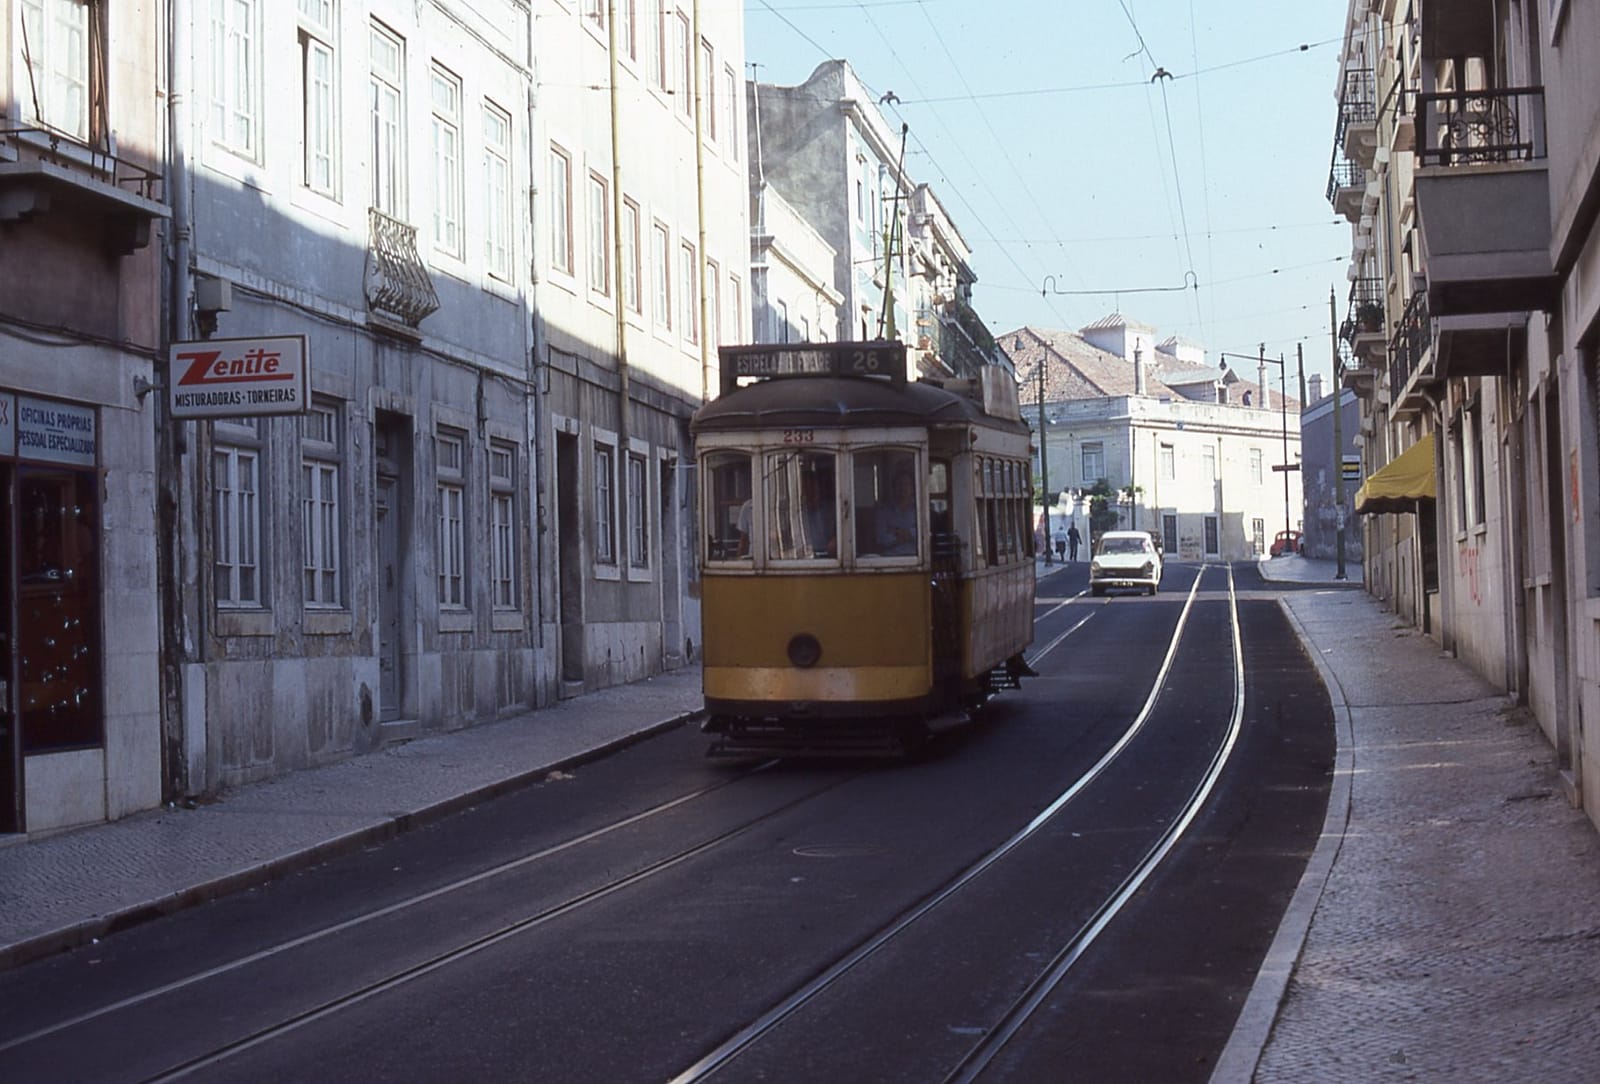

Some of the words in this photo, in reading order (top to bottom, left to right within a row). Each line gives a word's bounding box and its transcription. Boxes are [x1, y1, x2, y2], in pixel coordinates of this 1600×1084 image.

[176, 349, 294, 386] Zenite
[737, 354, 777, 373] ESTRELA
[853, 351, 879, 370] 26
[175, 392, 240, 407] MISTURADORAS
[247, 388, 296, 404] TORNEIRAS
[21, 407, 55, 426] OFICINAS
[18, 430, 47, 449] PESSOAL
[783, 429, 814, 442] 233
